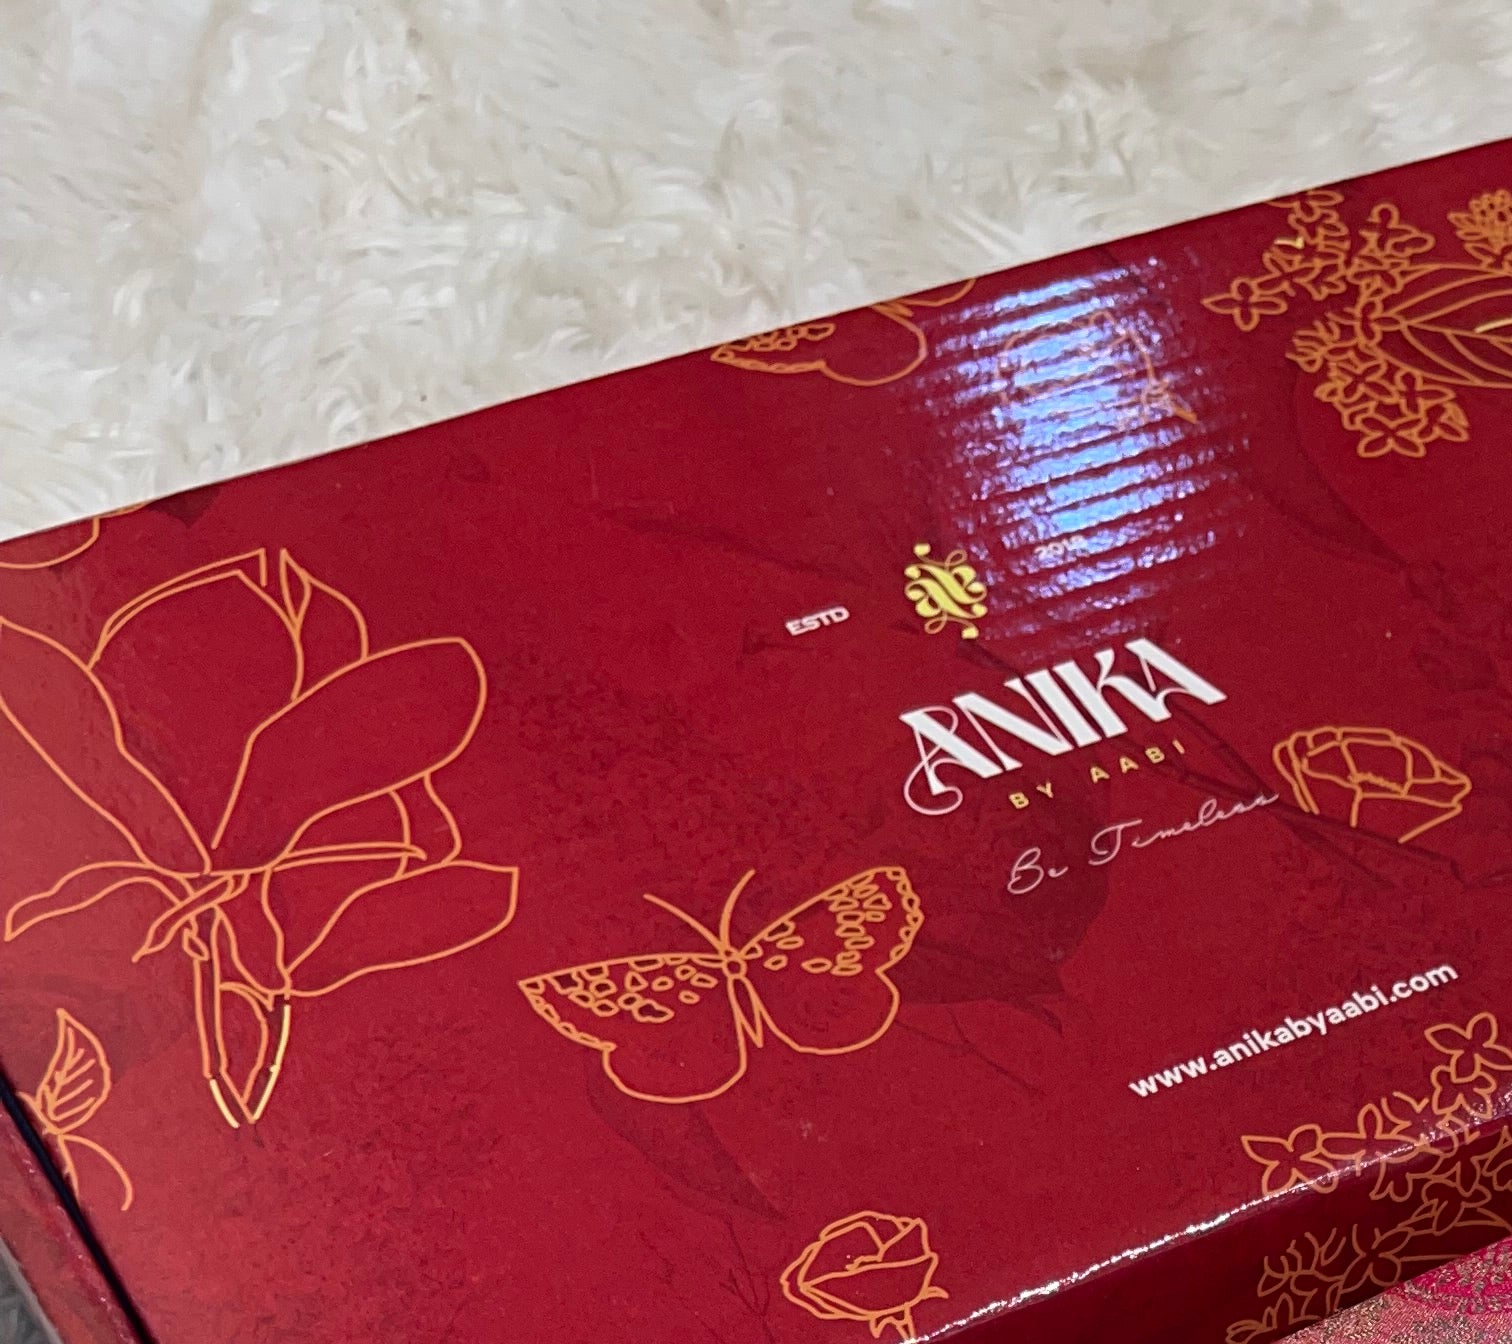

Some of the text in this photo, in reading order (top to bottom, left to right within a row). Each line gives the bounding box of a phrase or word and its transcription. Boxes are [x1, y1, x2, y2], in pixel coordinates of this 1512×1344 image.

[785, 606, 850, 636] ESTD
[899, 637, 1228, 816] ANIKA
[1009, 738, 1187, 810] BY AABI
[1006, 793, 1281, 895] Be Timeless
[1128, 963, 1459, 1098] www.anikabyaabi.com
